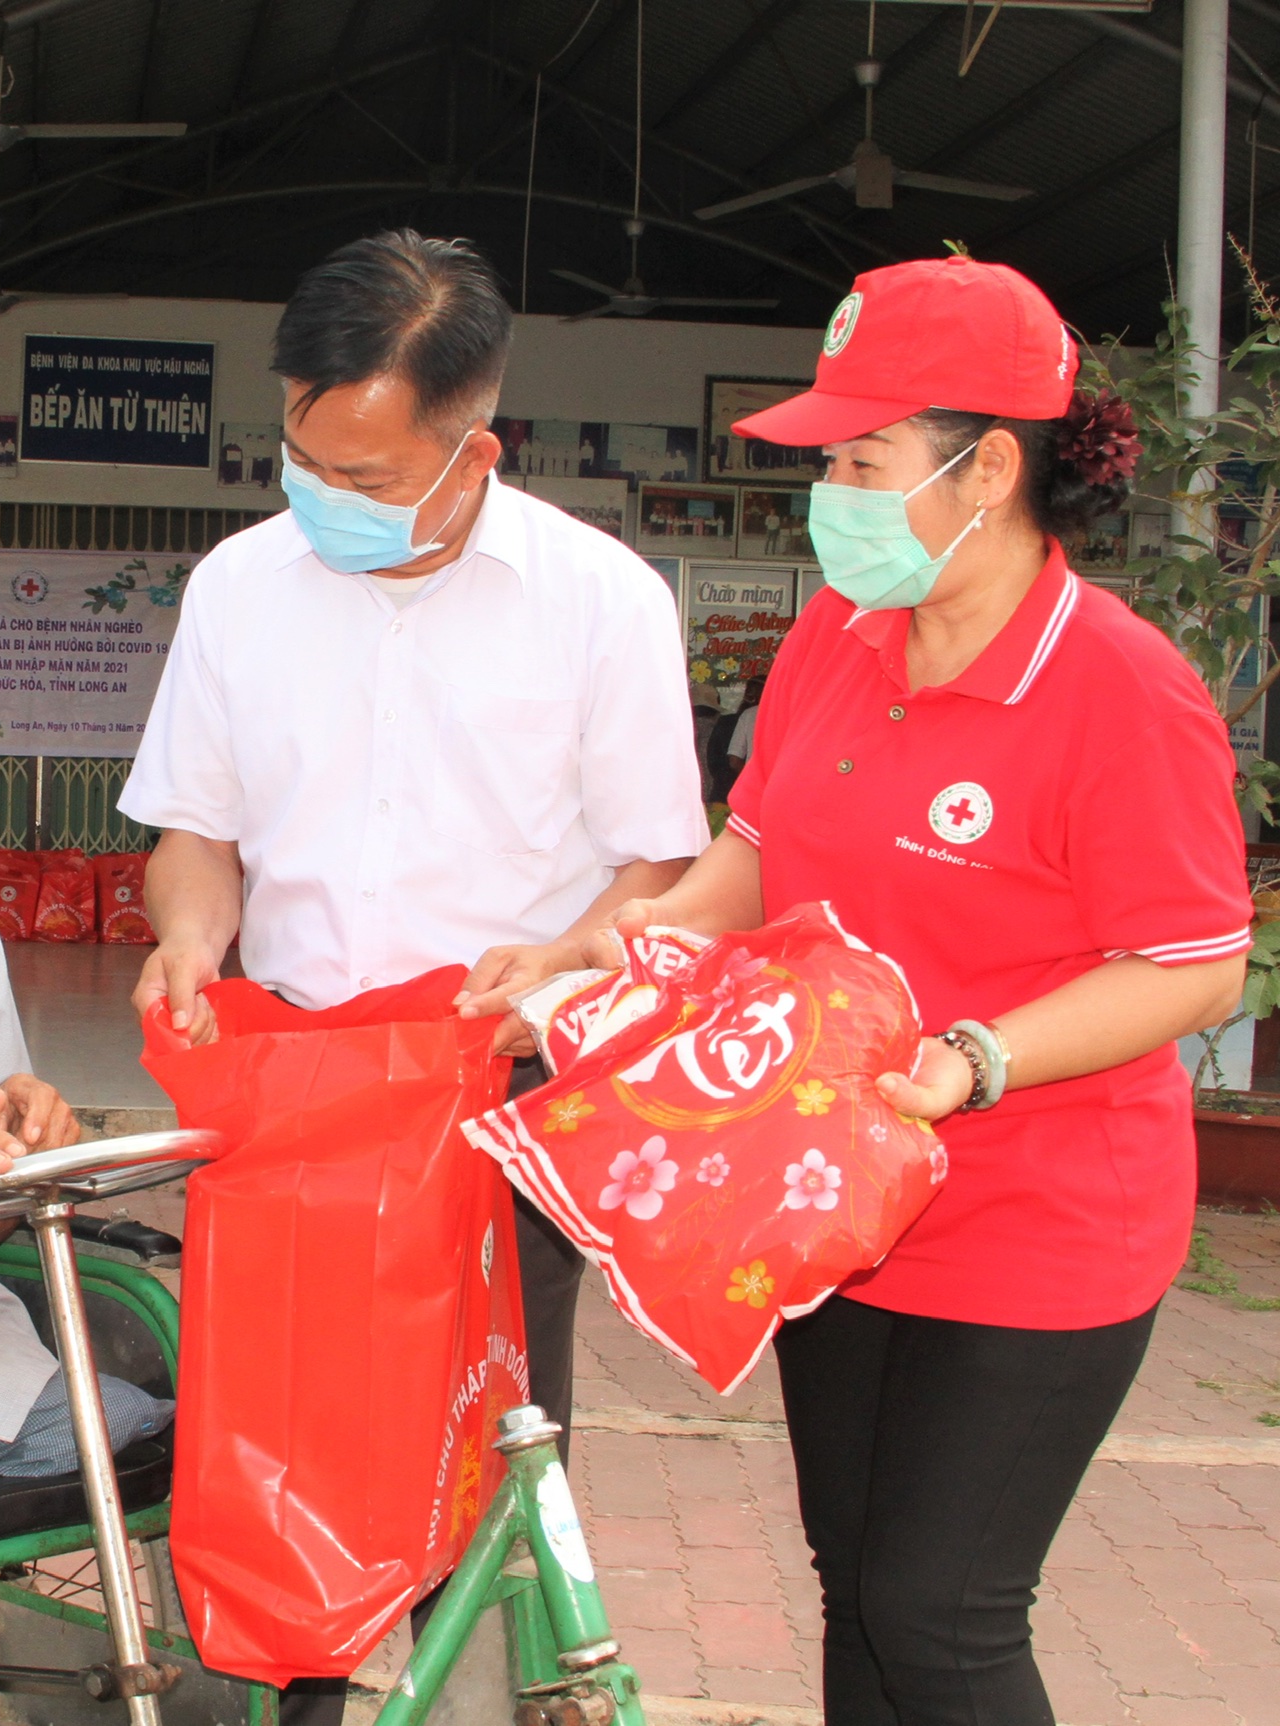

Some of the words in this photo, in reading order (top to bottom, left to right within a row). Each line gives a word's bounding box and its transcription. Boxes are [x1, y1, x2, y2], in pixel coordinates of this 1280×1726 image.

[30, 351, 54, 371] BỆNH
[58, 352, 78, 372] VIỆN
[82, 355, 94, 370] ĐA
[97, 356, 120, 371] KHOA
[123, 357, 141, 372] KHU
[144, 358, 162, 377] VỰC
[163, 358, 181, 377] HẬU
[183, 359, 210, 376] NGHĨA
[30, 383, 71, 428] BẾP
[74, 388, 103, 430] ĂN
[110, 389, 139, 431] TỪ
[144, 393, 206, 442] THIỆN
[699, 582, 736, 603] Chào
[10, 619, 33, 631] CHO
[37, 617, 66, 634] BỆNH
[70, 619, 101, 633] NHÂN
[105, 619, 143, 634] NGHÈO
[14, 638, 24, 653] BỊ
[28, 636, 51, 651] ẢNH
[156, 643, 168, 654] 19
[15, 657, 46, 674] NHẬP
[49, 658, 73, 675] MẶN
[76, 659, 100, 673] NĂM
[104, 662, 128, 673] 2021
[50, 676, 75, 691] TỈNH
[79, 681, 108, 692] LONG
[111, 682, 127, 693] AN
[11, 721, 30, 732] Long
[48, 722, 67, 732] Ngày
[70, 722, 80, 731] 10
[82, 722, 106, 733] Tháng
[115, 723, 134, 732] Năm
[895, 836, 924, 854] TỈNH
[427, 1498, 441, 1551] HỘI
[436, 1422, 455, 1487] CHỮ
[451, 1358, 488, 1424] THẬP
